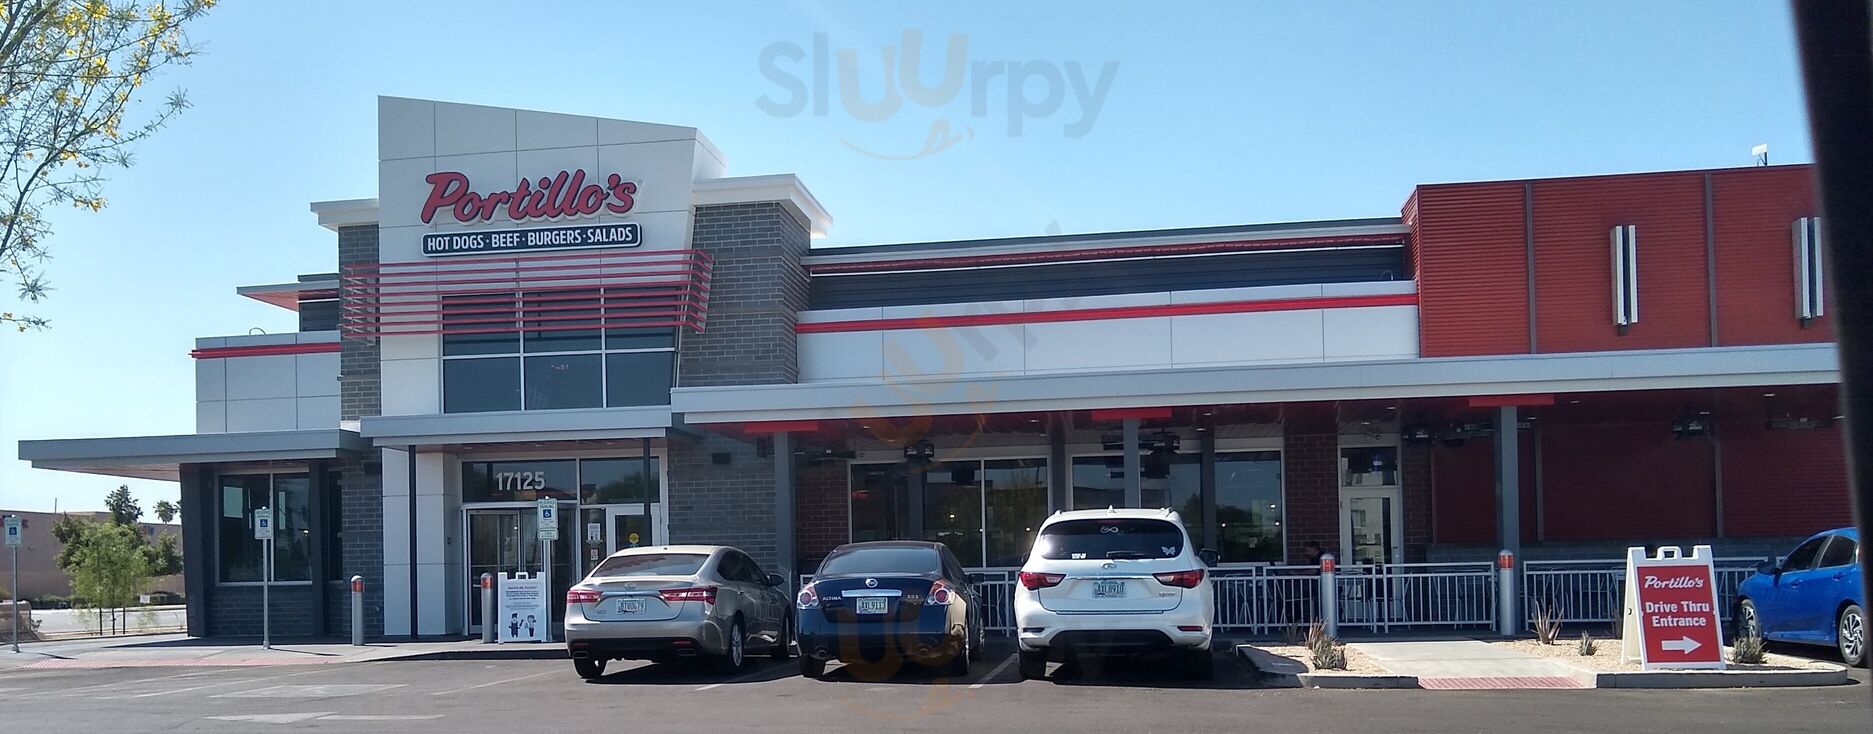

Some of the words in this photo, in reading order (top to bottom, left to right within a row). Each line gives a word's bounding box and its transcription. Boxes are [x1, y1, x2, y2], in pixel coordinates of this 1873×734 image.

[420, 168, 638, 225] Portillo's
[427, 236, 451, 251] HOT
[453, 234, 484, 250] DOGS
[491, 232, 520, 248] BEEF
[527, 229, 582, 246] BURGERS
[587, 227, 633, 243] SALADS
[496, 471, 546, 491] 17125
[1644, 575, 1704, 588] Portillo's
[1645, 601, 1678, 613] Drive
[1680, 600, 1710, 612] Thru
[1652, 615, 1707, 627] Entrance
